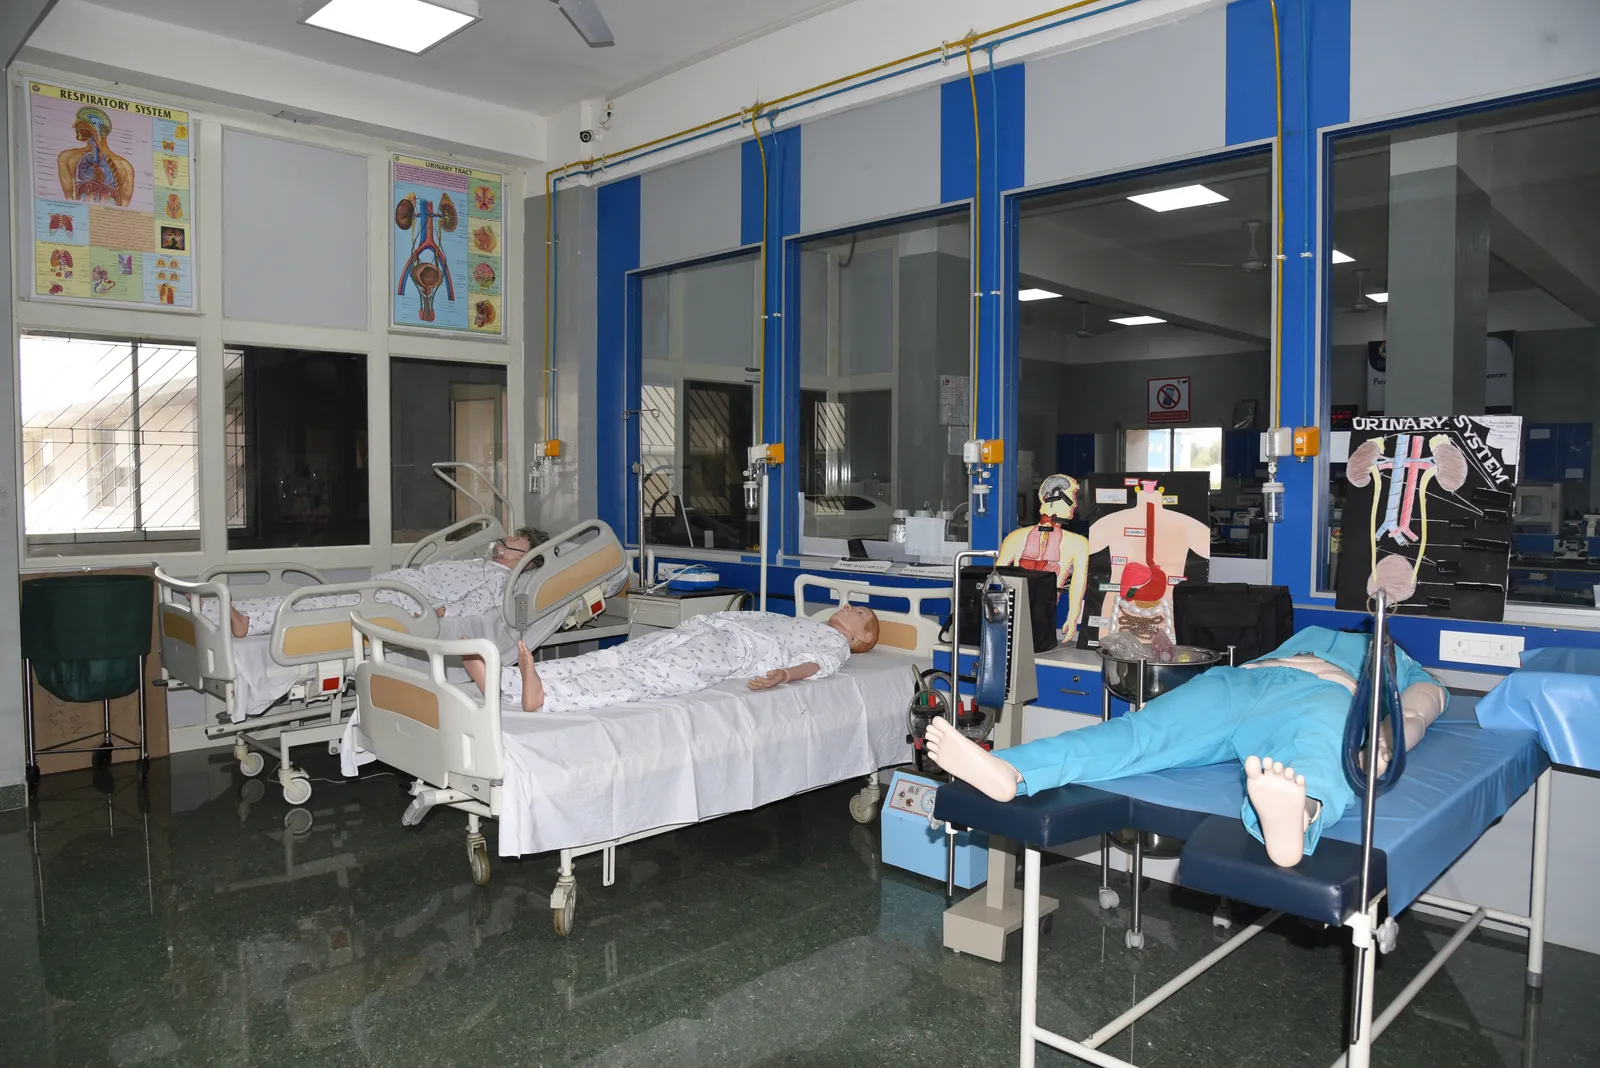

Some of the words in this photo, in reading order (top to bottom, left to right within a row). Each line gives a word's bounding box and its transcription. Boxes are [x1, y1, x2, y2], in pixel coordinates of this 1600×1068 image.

[60, 89, 130, 111] RESPIRATORY
[135, 104, 171, 119] SYSTEM
[425, 161, 453, 172] URINARY
[454, 167, 472, 176] TRACT
[1352, 415, 1450, 431] URINARY
[1454, 414, 1509, 485] SYSTEM
